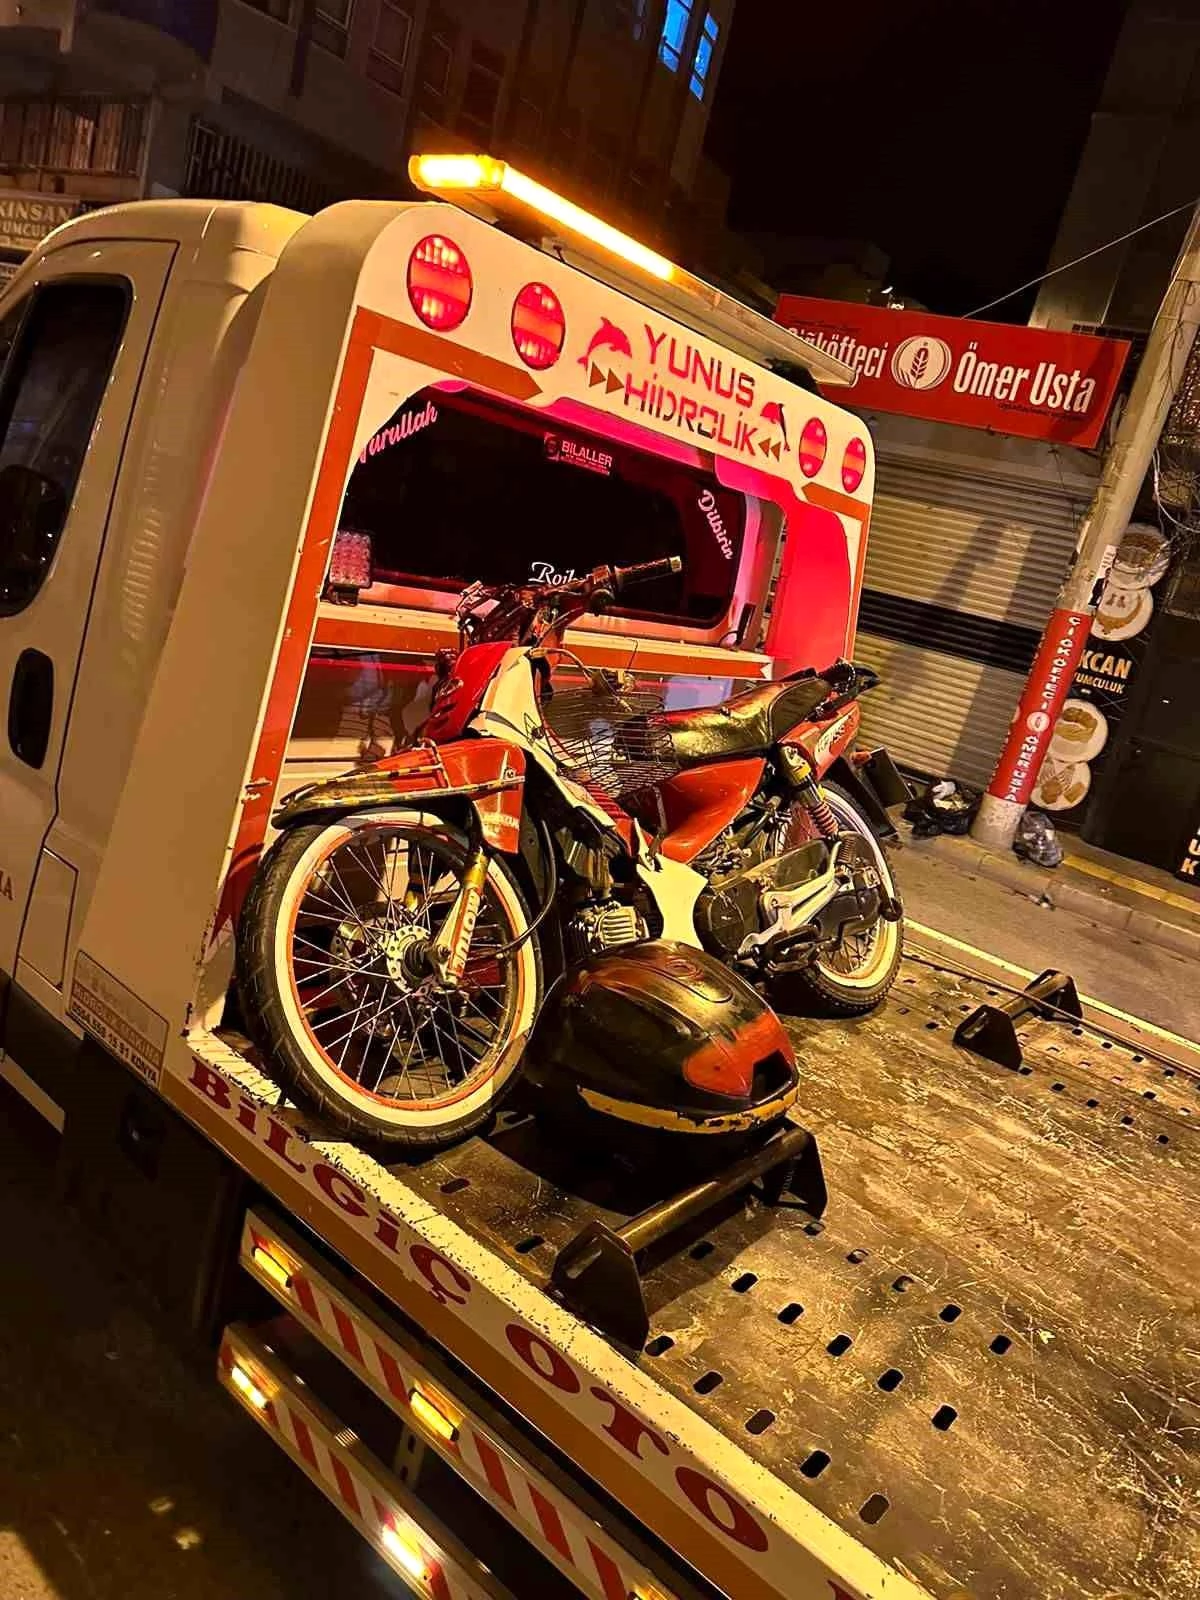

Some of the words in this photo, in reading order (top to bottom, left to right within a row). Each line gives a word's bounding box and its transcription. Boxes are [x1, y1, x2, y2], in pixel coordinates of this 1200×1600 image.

[644, 324, 755, 408] YUNUS
[787, 327, 888, 388] köfteci
[953, 341, 1030, 401] Ömer
[1029, 362, 1096, 413] Usta
[624, 372, 757, 456] HİDROLİK
[1073, 672, 1126, 694] UMCULUK
[505, 1323, 769, 1553] OTO
